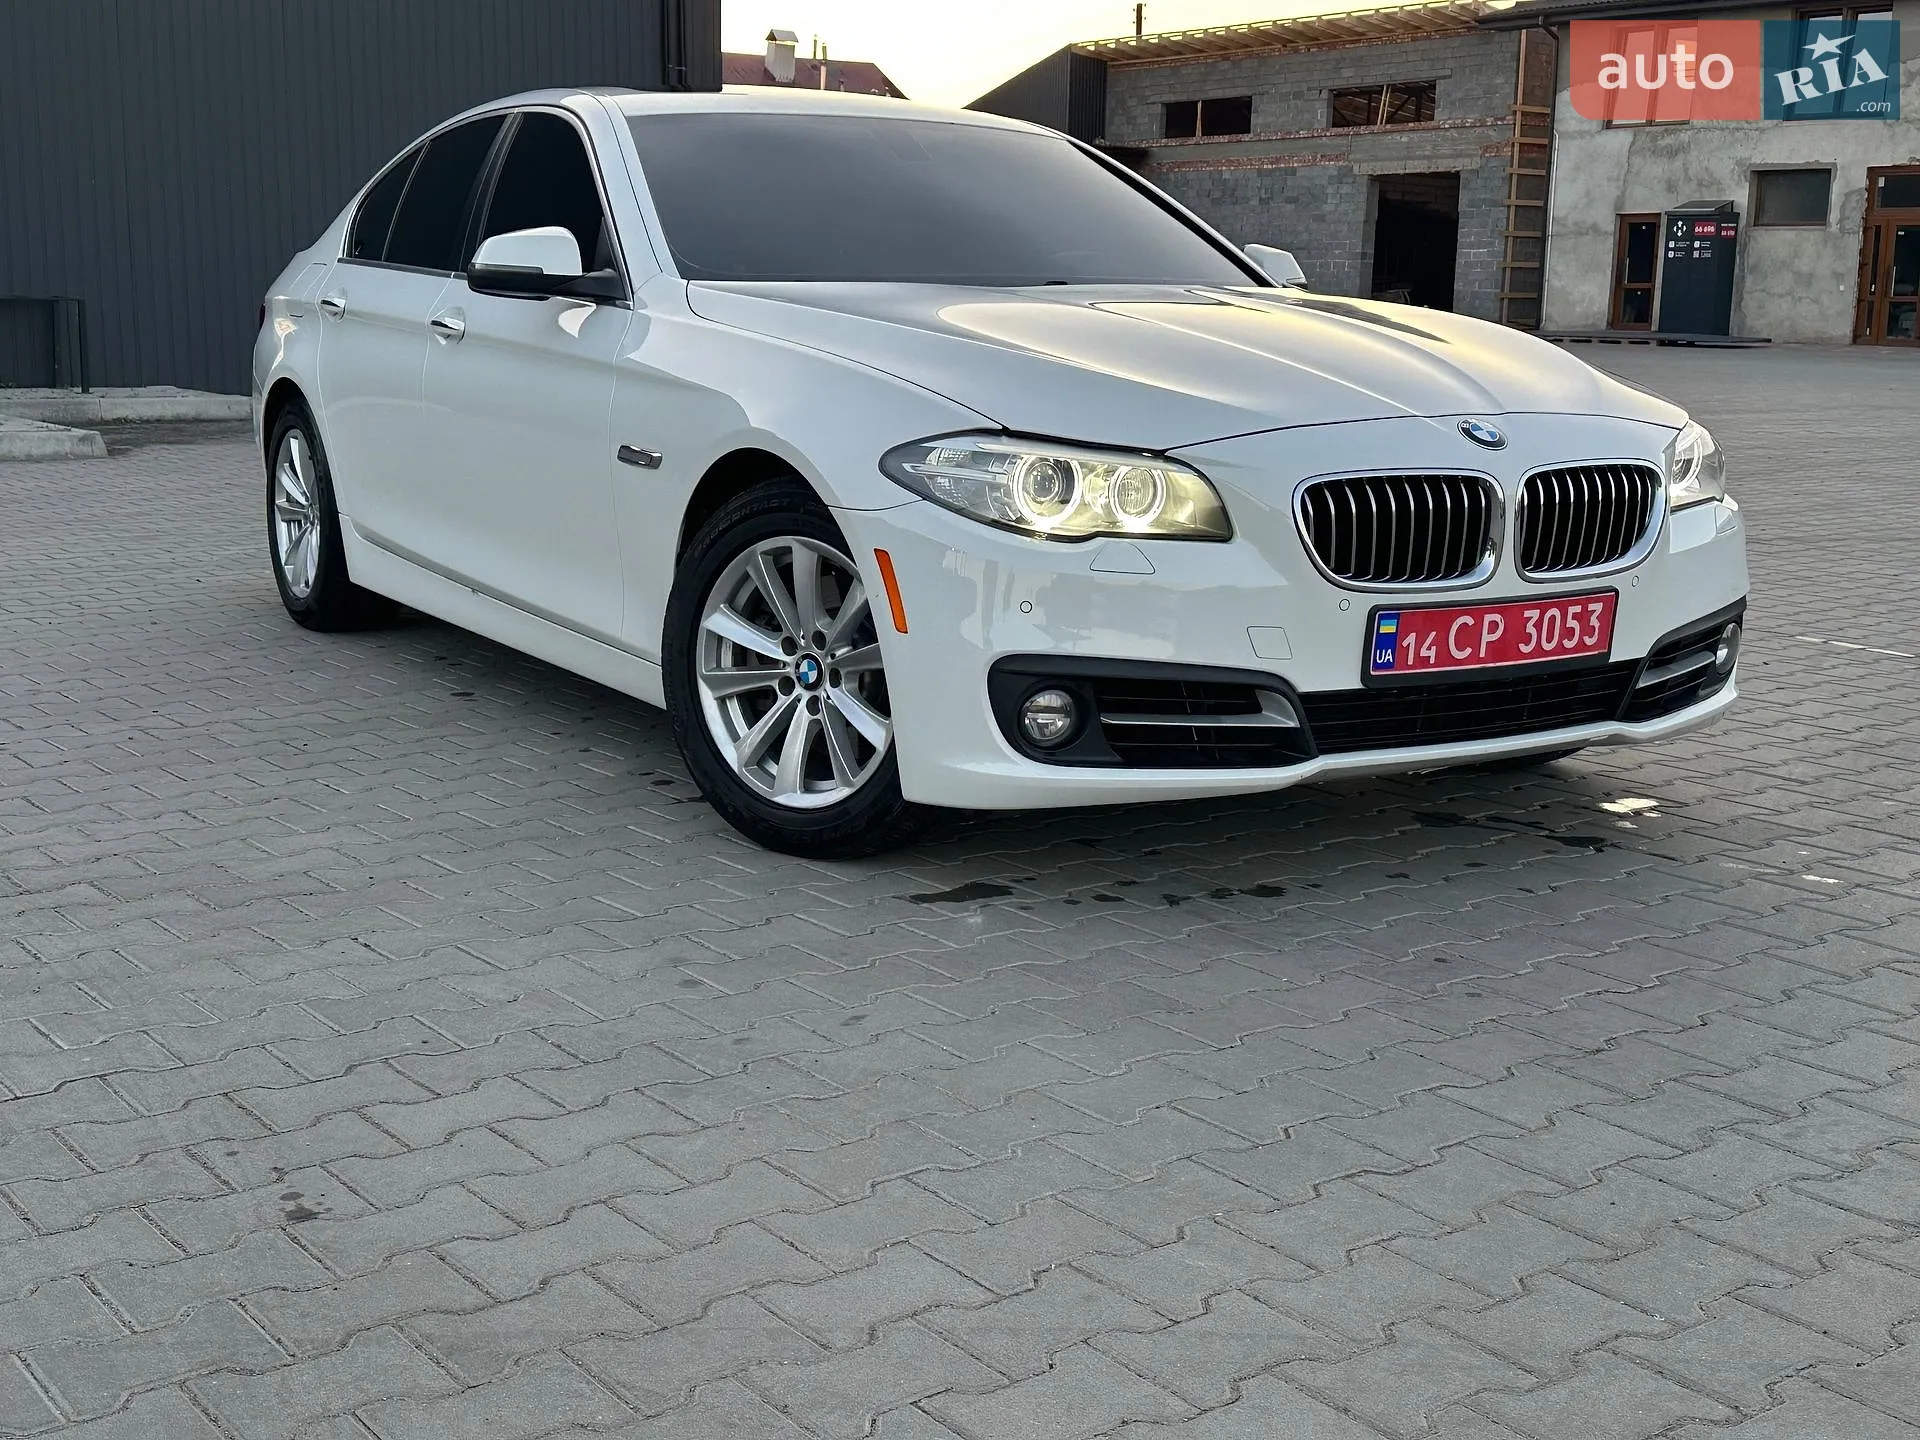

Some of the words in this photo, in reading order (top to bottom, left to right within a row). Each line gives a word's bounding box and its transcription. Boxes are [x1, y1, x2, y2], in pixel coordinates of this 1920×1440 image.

[1401, 632, 1437, 665] 14
[1448, 613, 1505, 660] CP
[1518, 602, 1604, 654] 3053
[1376, 649, 1393, 664] UA
